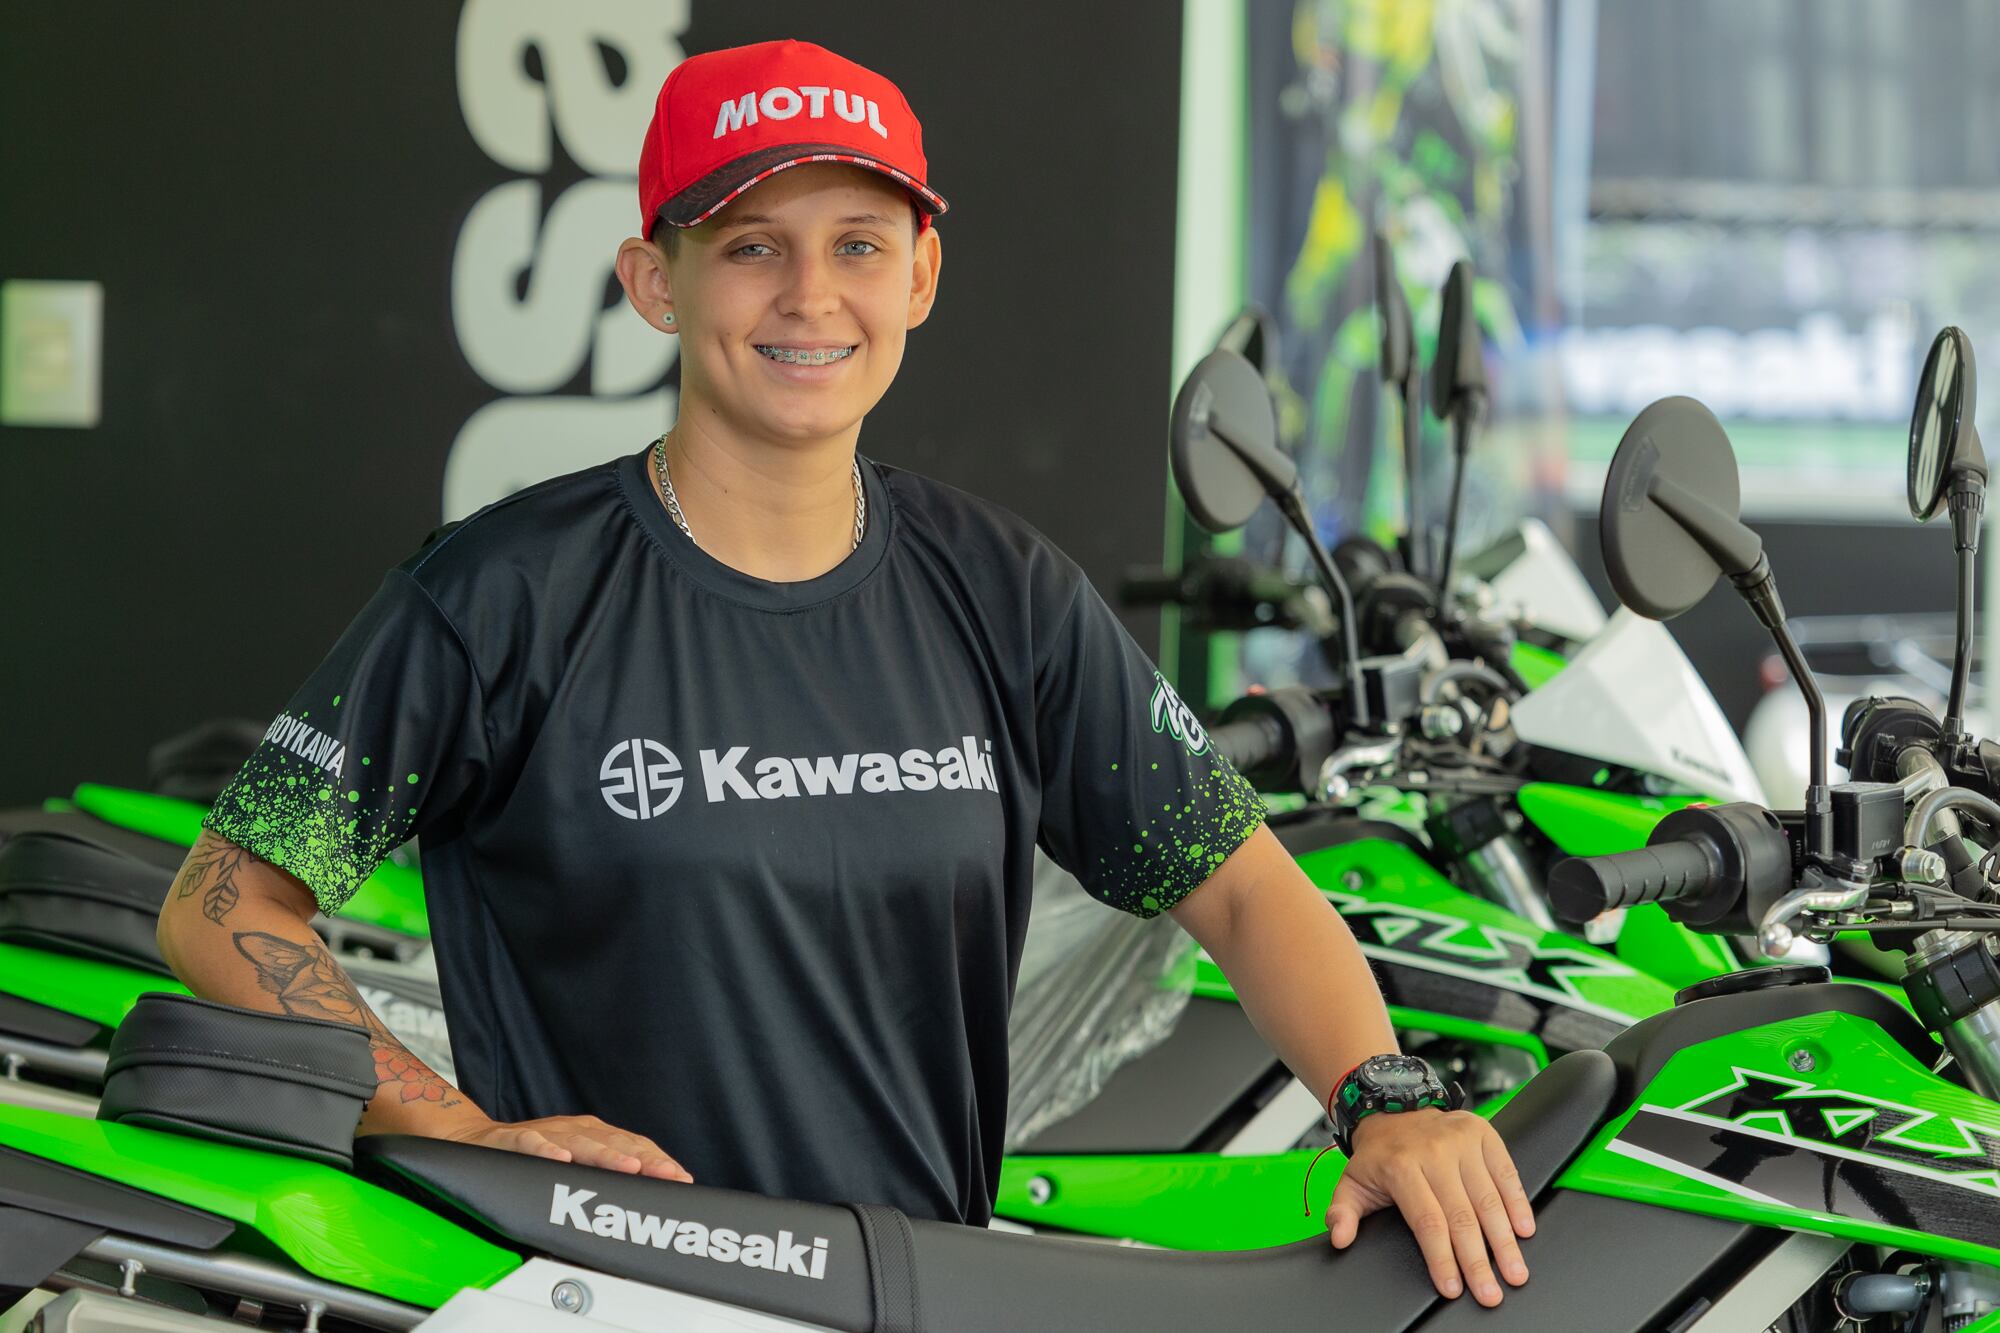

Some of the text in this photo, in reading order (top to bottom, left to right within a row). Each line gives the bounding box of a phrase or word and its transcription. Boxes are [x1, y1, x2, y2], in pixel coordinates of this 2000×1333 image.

[713, 86, 888, 139] MOTUL
[737, 177, 759, 194] MOTUL
[772, 159, 798, 174] MOTUL
[812, 153, 838, 162] MOTUL
[853, 156, 877, 168] MOTUL
[890, 168, 911, 184] MOTUL
[263, 713, 346, 779] SOYKAWA
[699, 735, 999, 803] Kawasaki
[549, 1183, 829, 1280] Kawasaki
